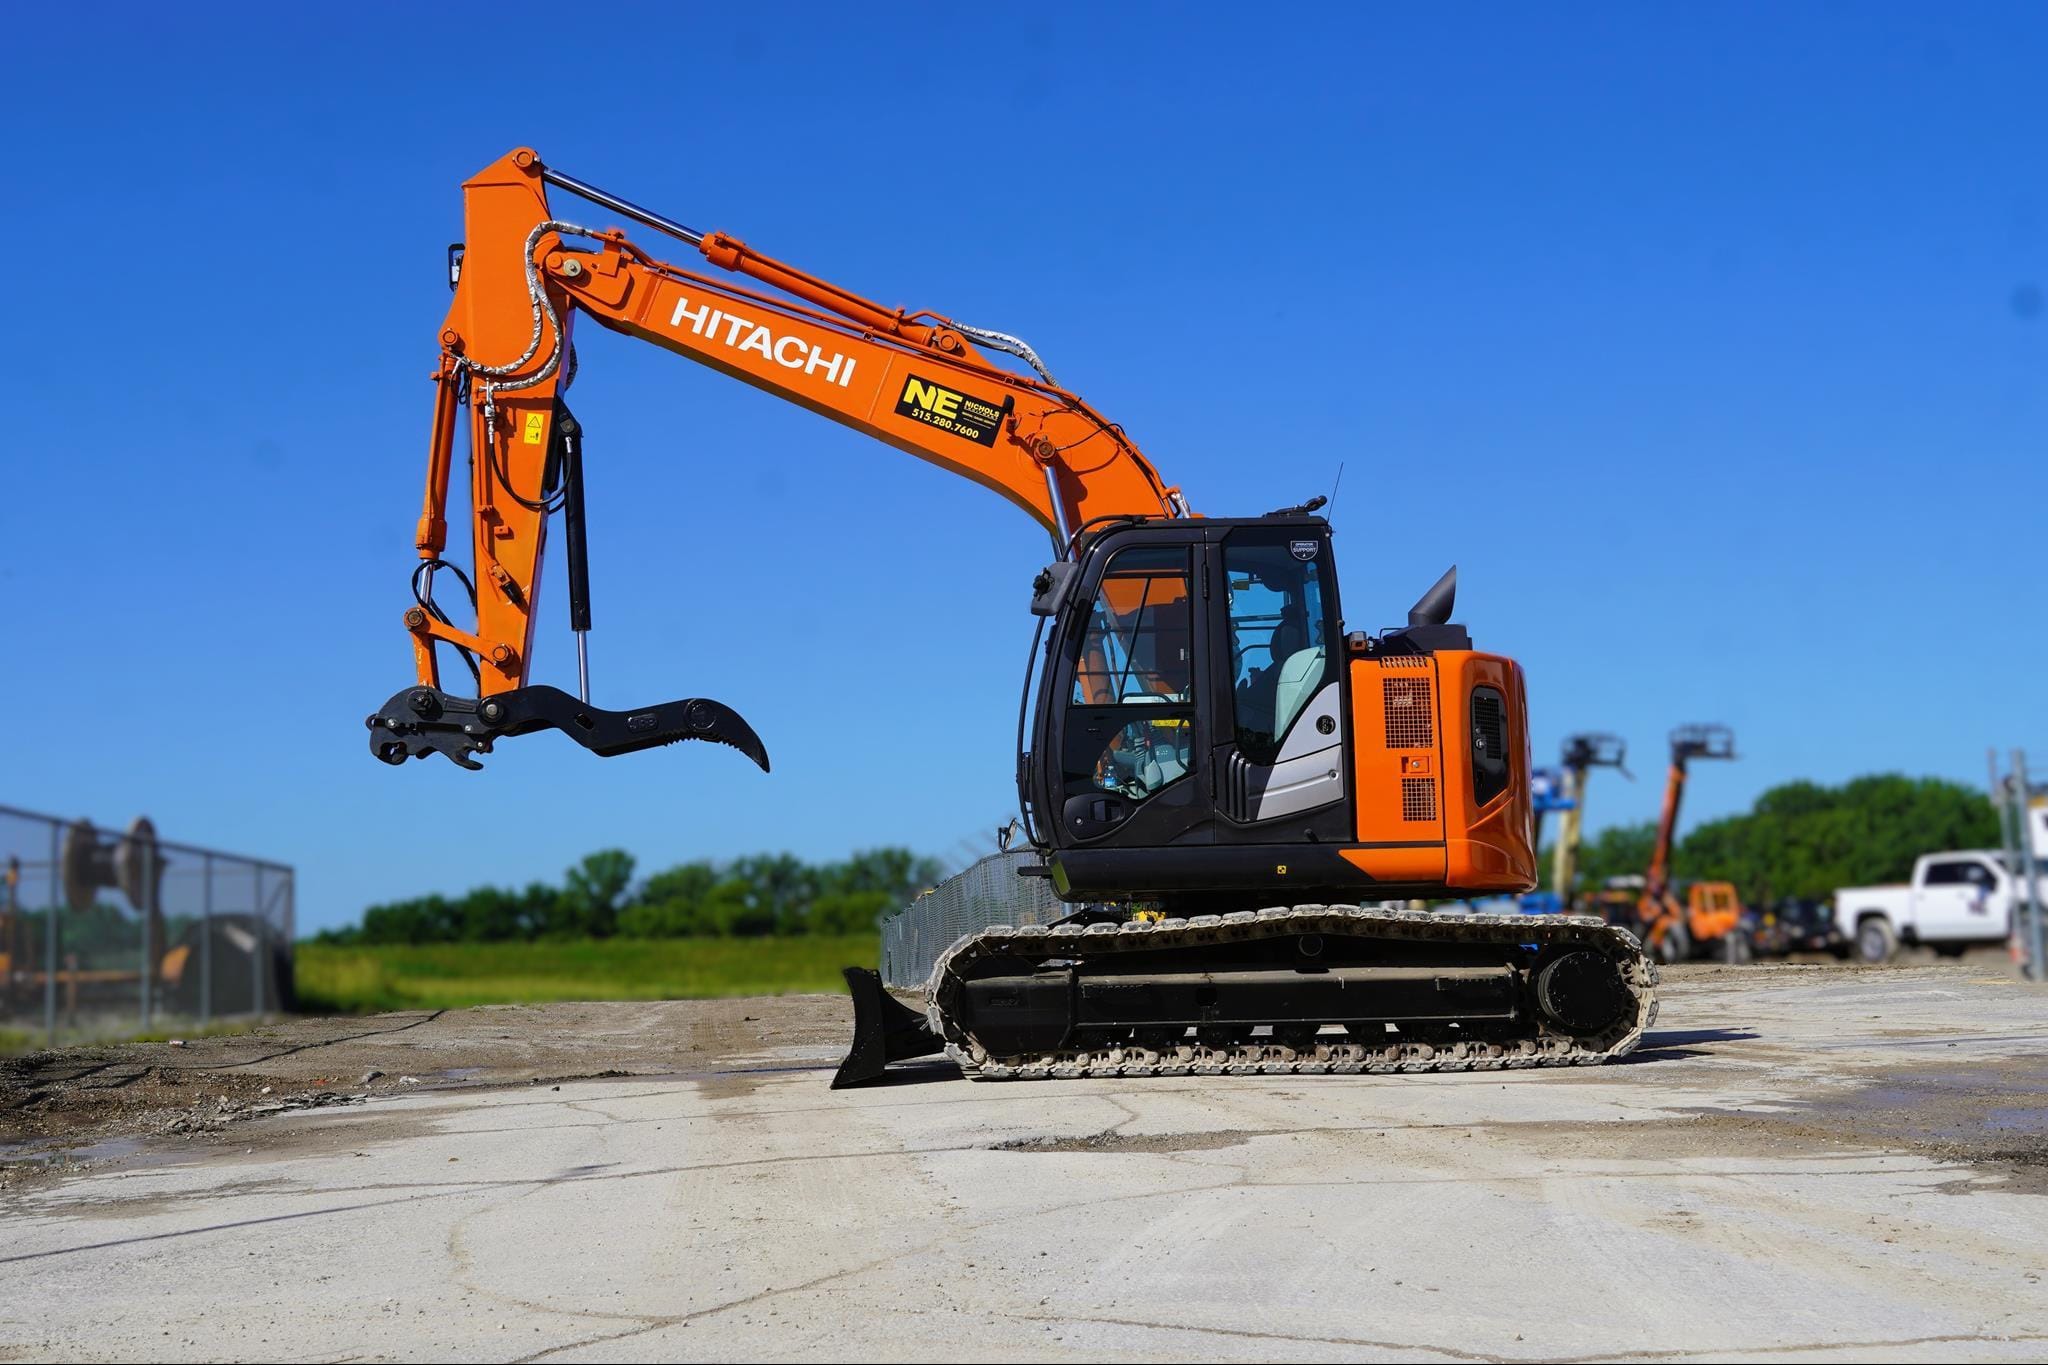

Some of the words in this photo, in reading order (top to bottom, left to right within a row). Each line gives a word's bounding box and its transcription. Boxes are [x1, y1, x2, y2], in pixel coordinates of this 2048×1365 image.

[670, 297, 856, 387] HITACHI
[903, 378, 963, 420] NE
[965, 400, 1000, 417] NICHOLS
[911, 408, 979, 438] 515.280.7600
